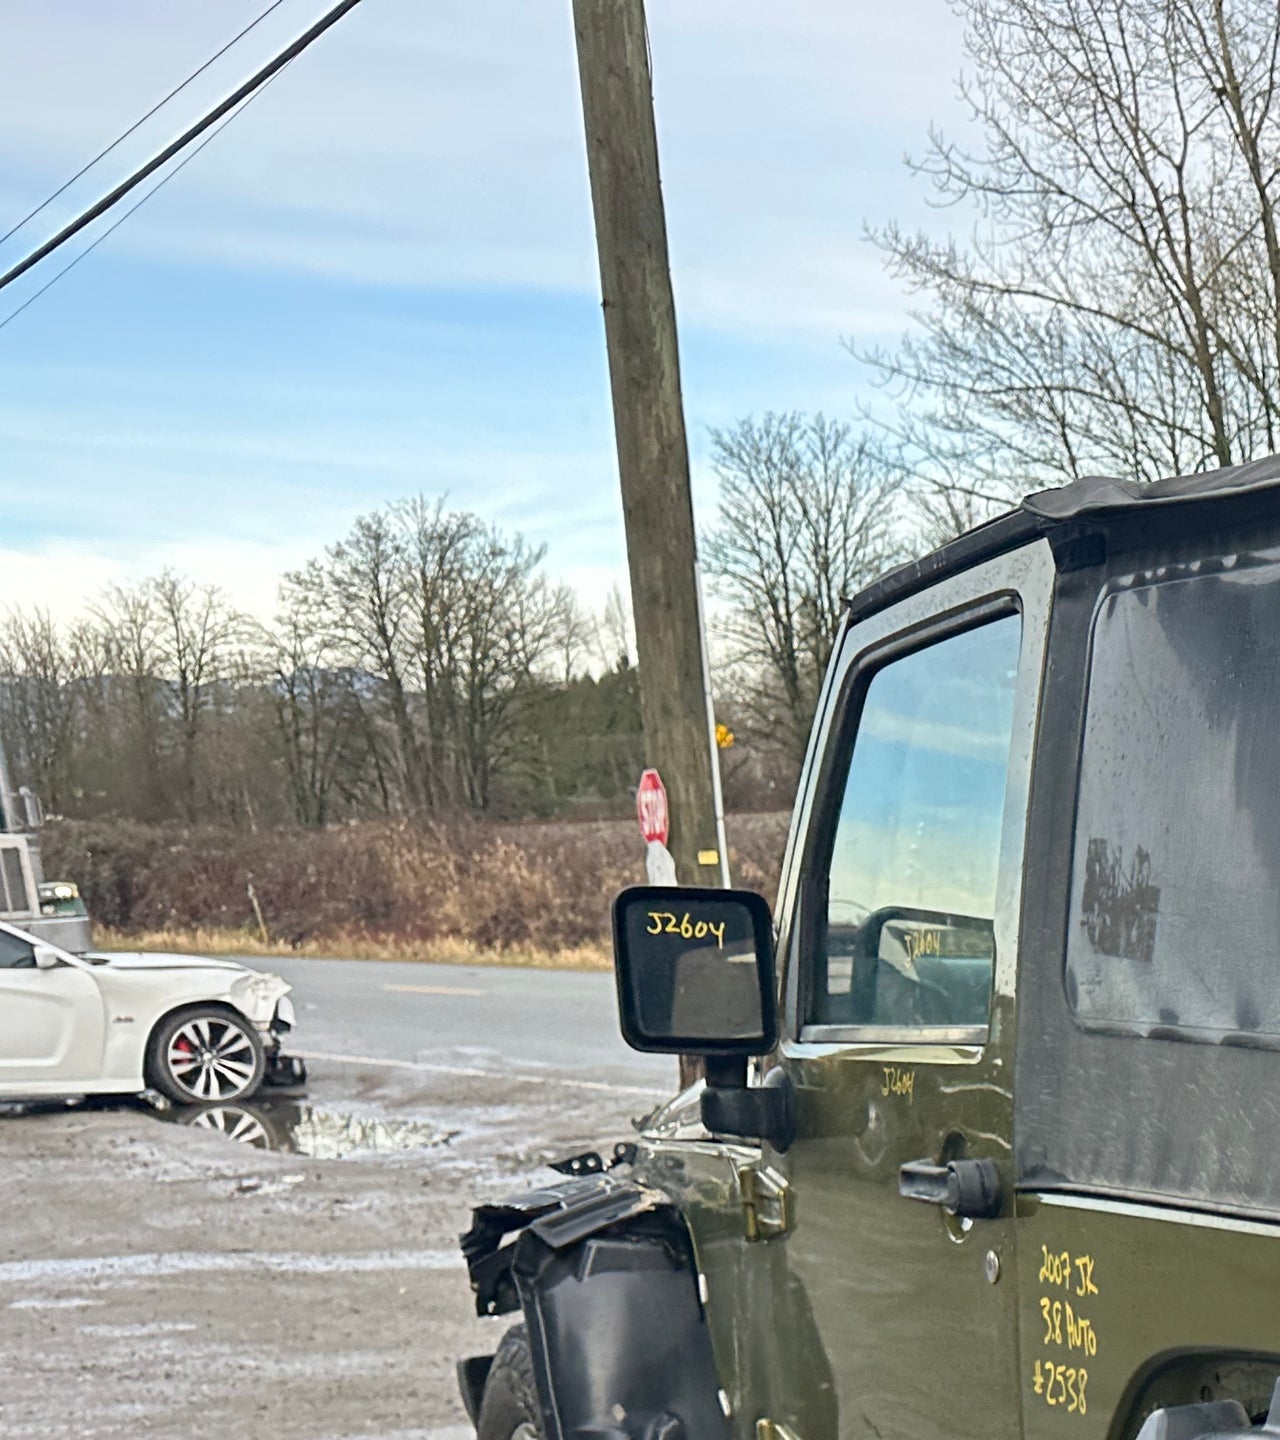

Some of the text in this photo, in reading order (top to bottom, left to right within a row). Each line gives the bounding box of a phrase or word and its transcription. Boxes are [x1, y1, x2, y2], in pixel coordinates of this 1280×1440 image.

[646, 912, 725, 951] J2604
[1039, 1244, 1098, 1296] 2007 JK
